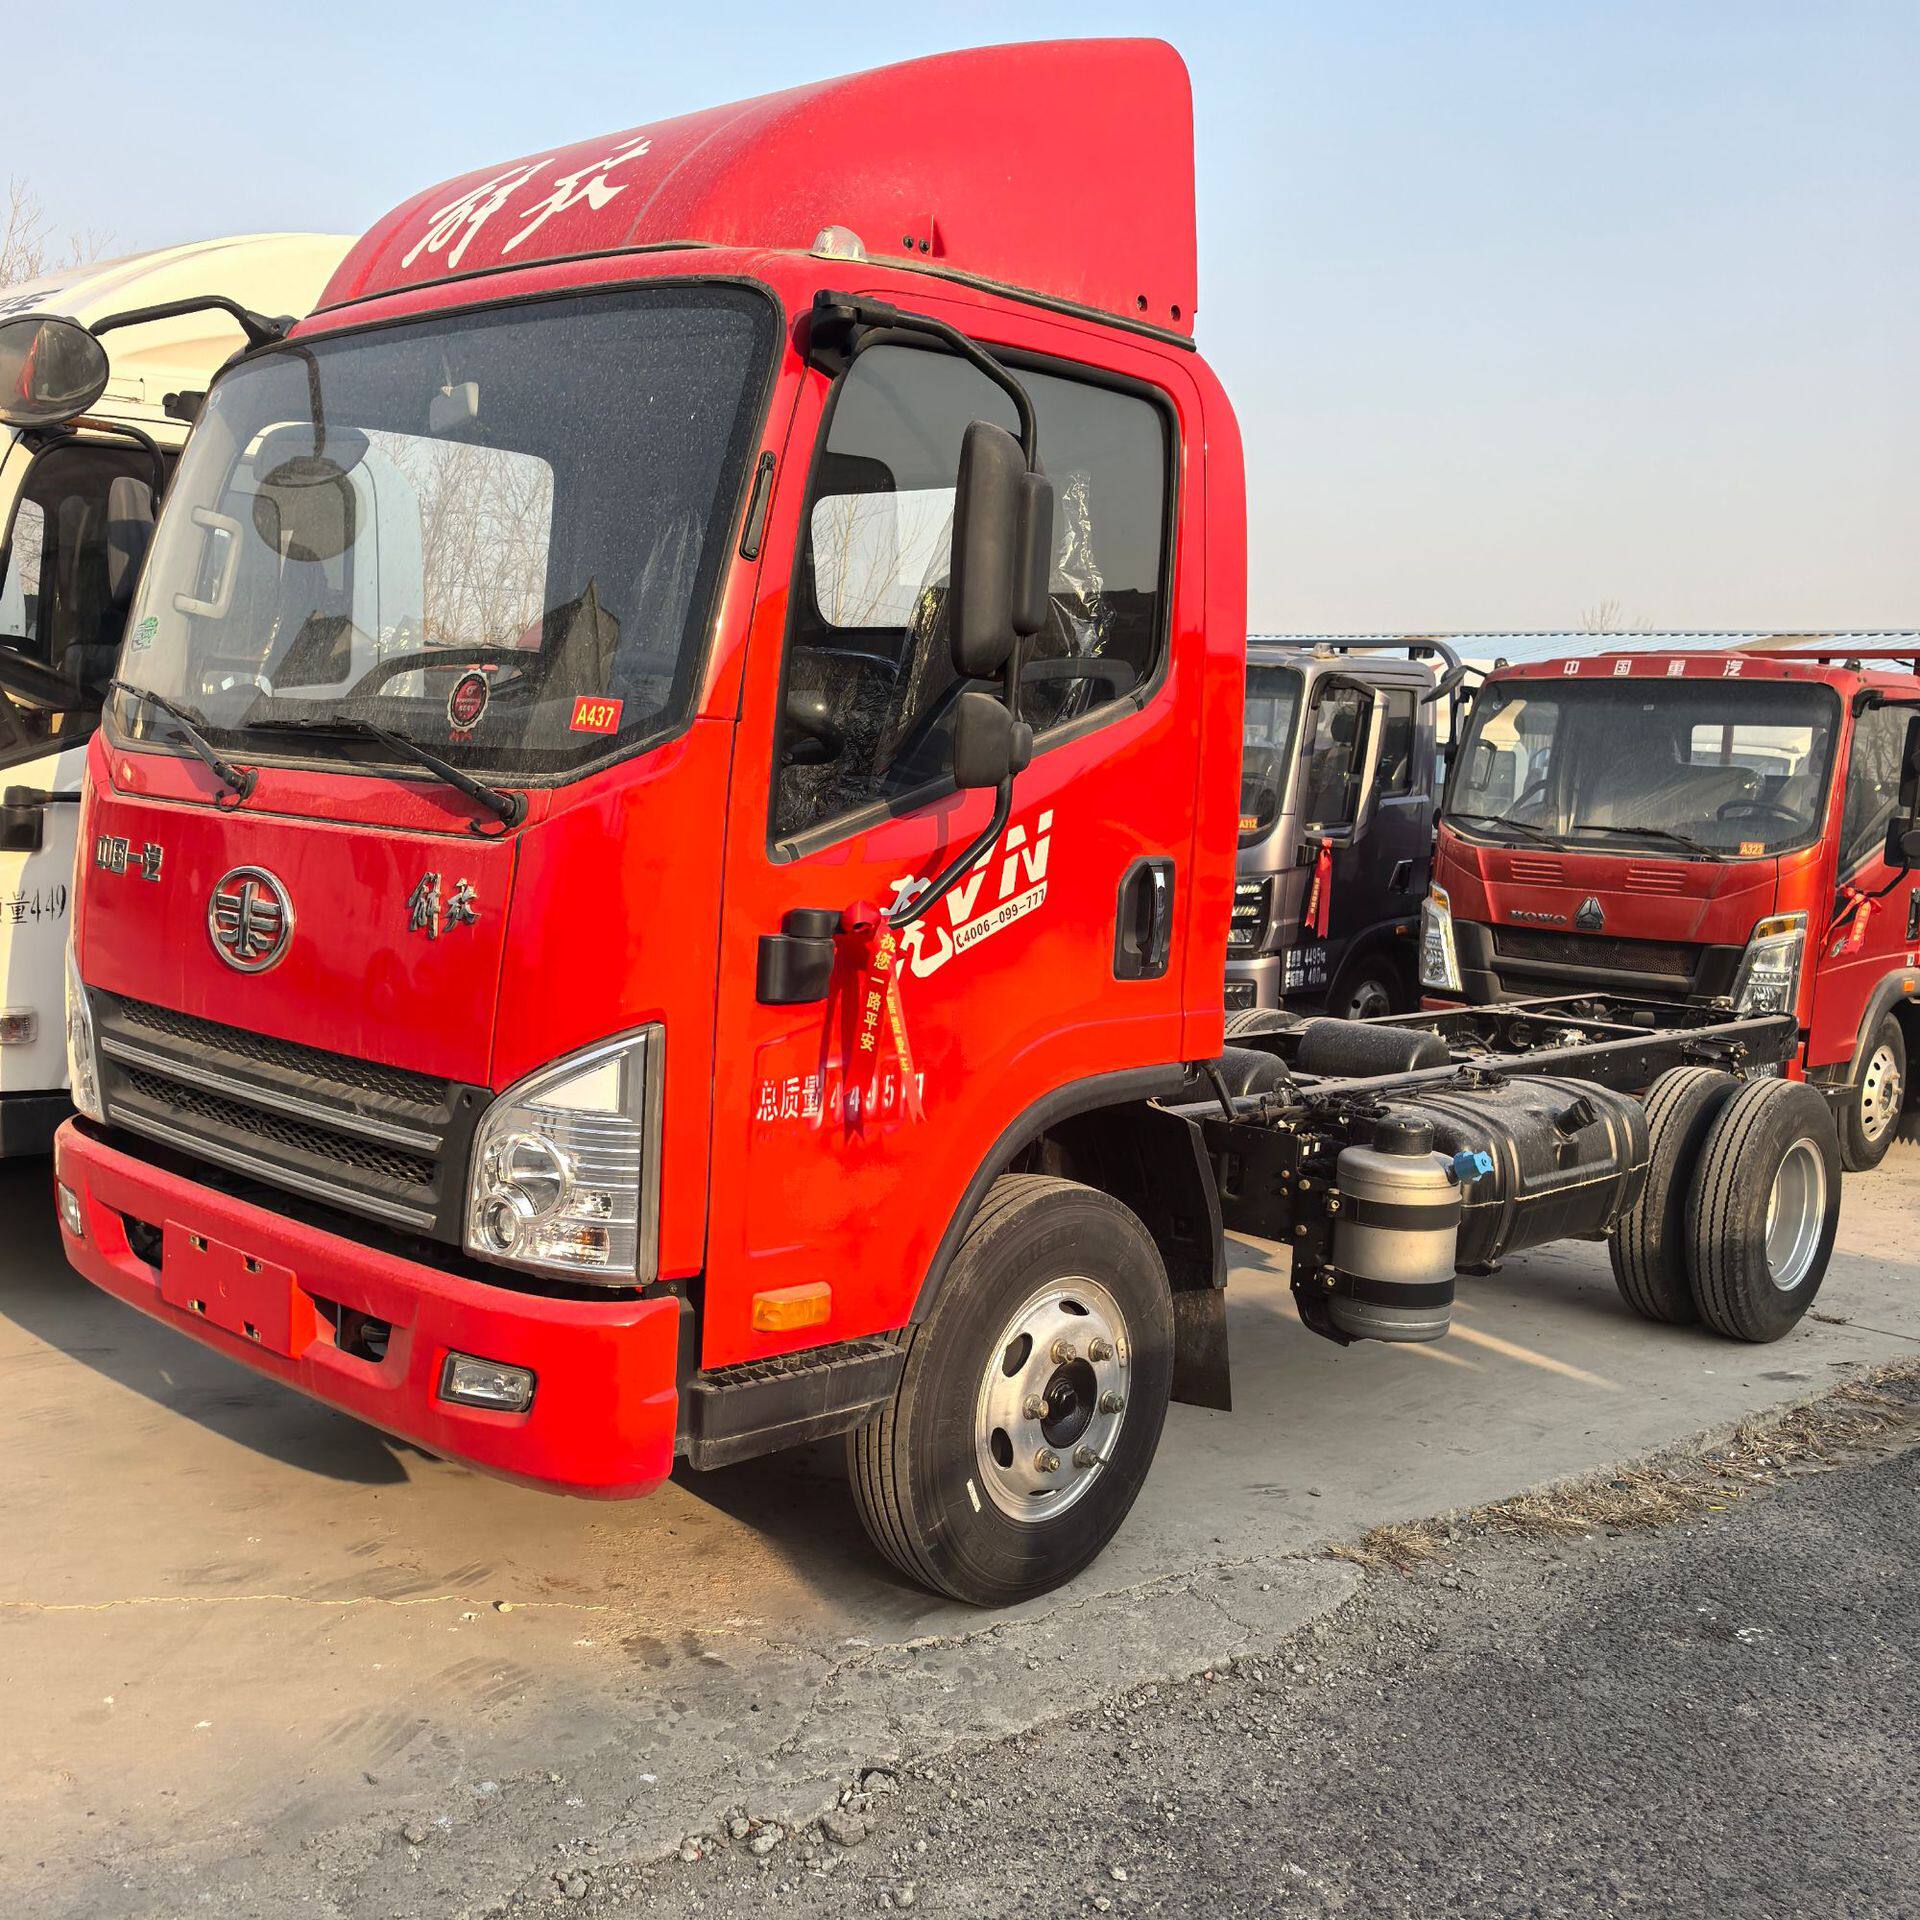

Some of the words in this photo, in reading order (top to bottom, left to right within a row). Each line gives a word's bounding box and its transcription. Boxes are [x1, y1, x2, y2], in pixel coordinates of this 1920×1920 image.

[1563, 660, 1745, 677] 中国重汽
[575, 704, 615, 728] A437
[96, 834, 164, 882] 中国一汽
[409, 871, 482, 940] 解放
[963, 888, 1046, 944] 4006-099-777
[1510, 909, 1567, 926] HOWO
[757, 1075, 820, 1121] 总质量
